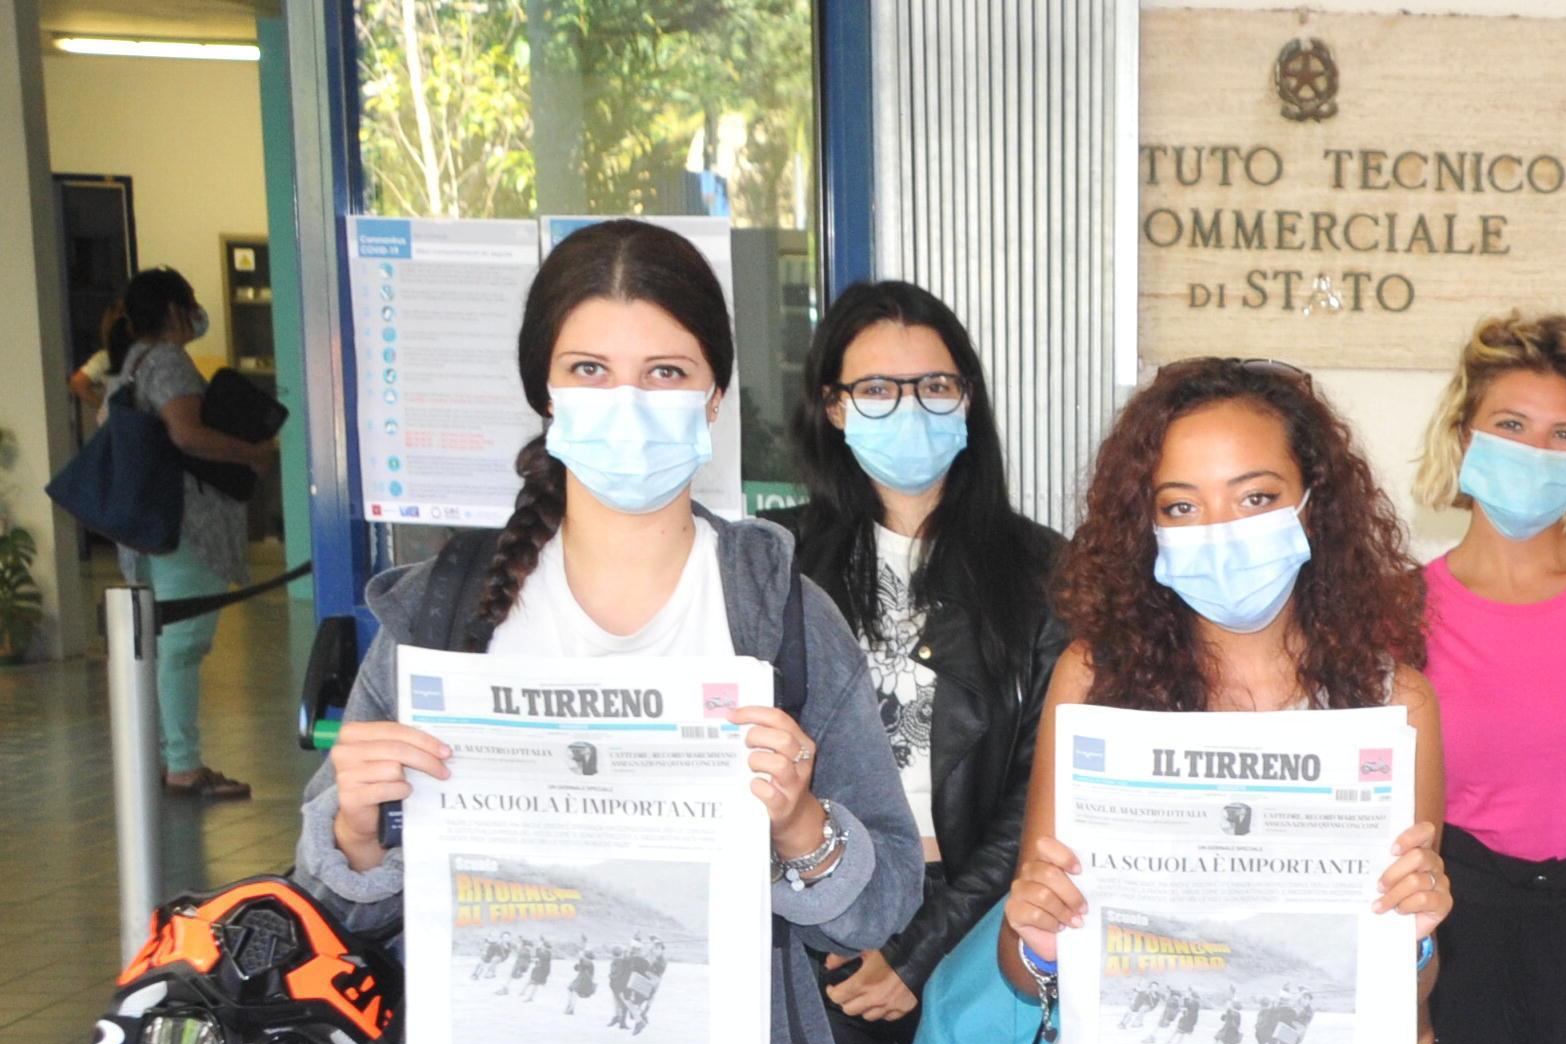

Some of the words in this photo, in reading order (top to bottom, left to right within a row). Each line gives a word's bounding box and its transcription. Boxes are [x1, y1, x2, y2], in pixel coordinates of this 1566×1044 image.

[1323, 149, 1566, 195] TECNICO
[1143, 208, 1511, 256] OMMERCIALE
[1188, 283, 1227, 309] DI
[490, 685, 521, 716] IL
[521, 687, 665, 719] TIRRENO
[1152, 748, 1180, 777] IL
[1183, 750, 1321, 781] TIRRENO
[472, 794, 560, 814] SCUOLA
[581, 796, 724, 819] IMPORTANTE
[1120, 854, 1208, 873] SCUOLA
[1230, 857, 1371, 875] IMPORTANTE
[487, 902, 577, 924] FUTURO
[1136, 954, 1228, 975] FUTURO
